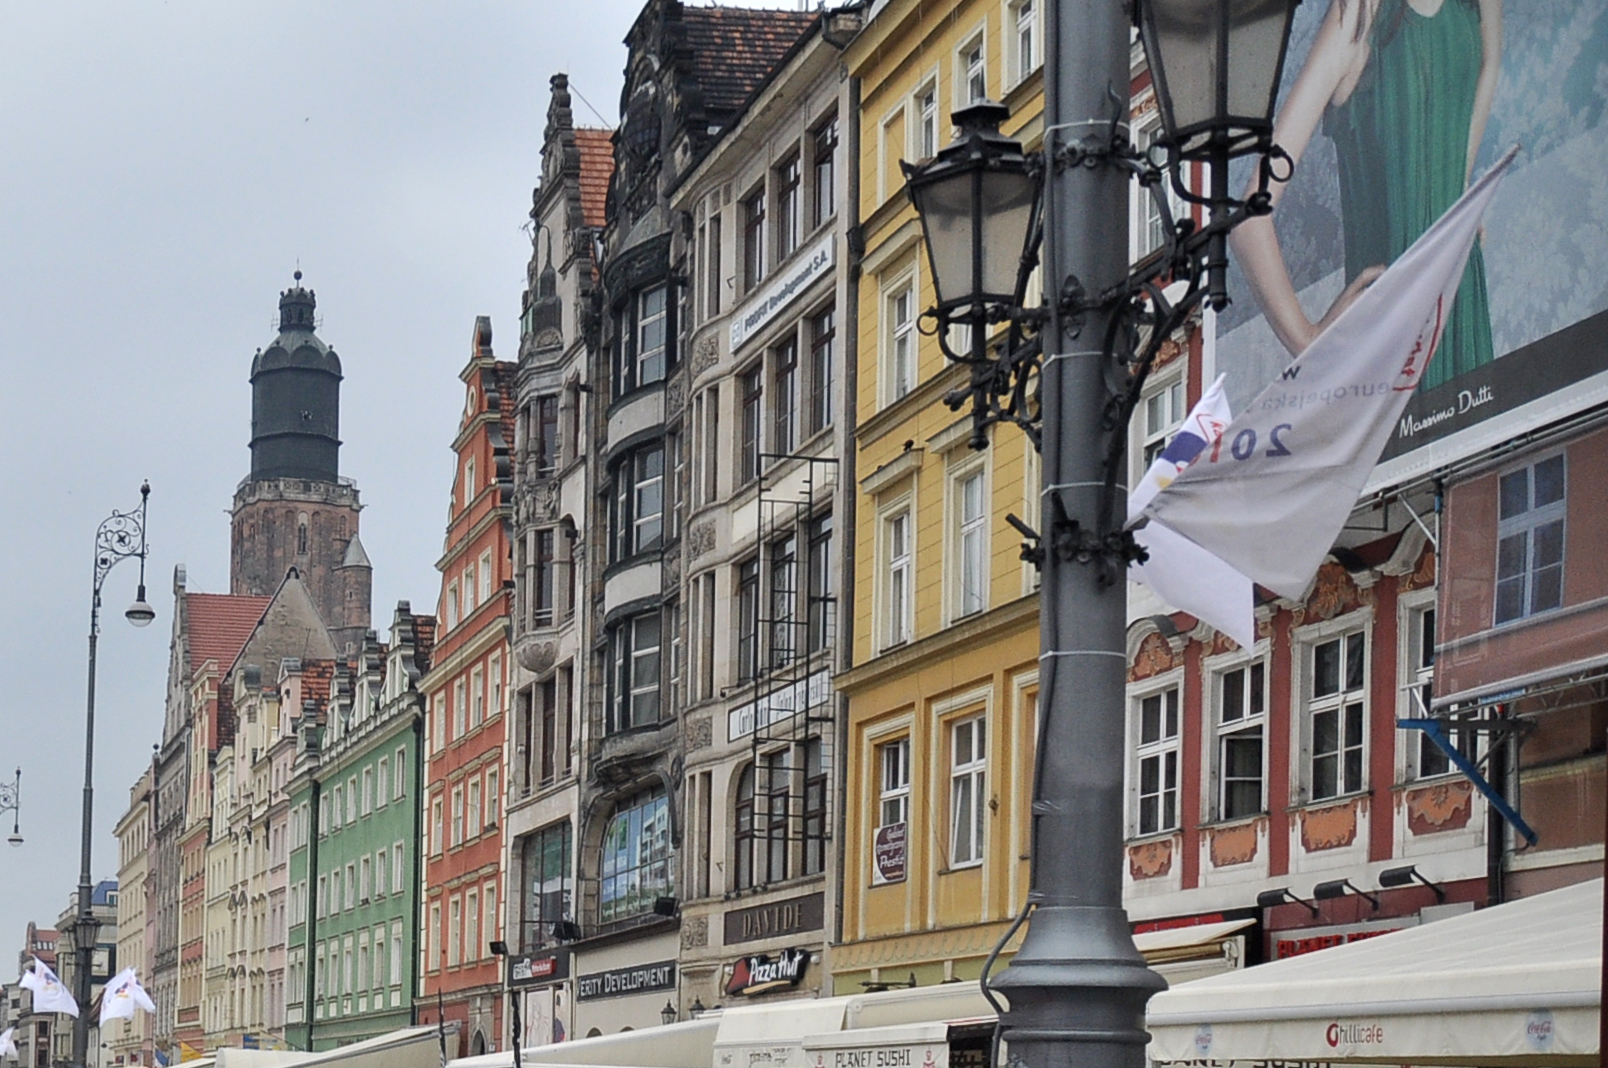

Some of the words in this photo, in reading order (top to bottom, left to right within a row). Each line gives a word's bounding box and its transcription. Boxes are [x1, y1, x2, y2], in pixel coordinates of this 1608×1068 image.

[1399, 406, 1455, 438] Massimo
[1458, 385, 1494, 414] Dutti
[743, 903, 803, 938] DAVIDE
[748, 957, 777, 986] Pizza
[777, 950, 804, 979] Hut
[835, 1051, 873, 1068] PLANET
[876, 1048, 911, 1068] SUSHI
